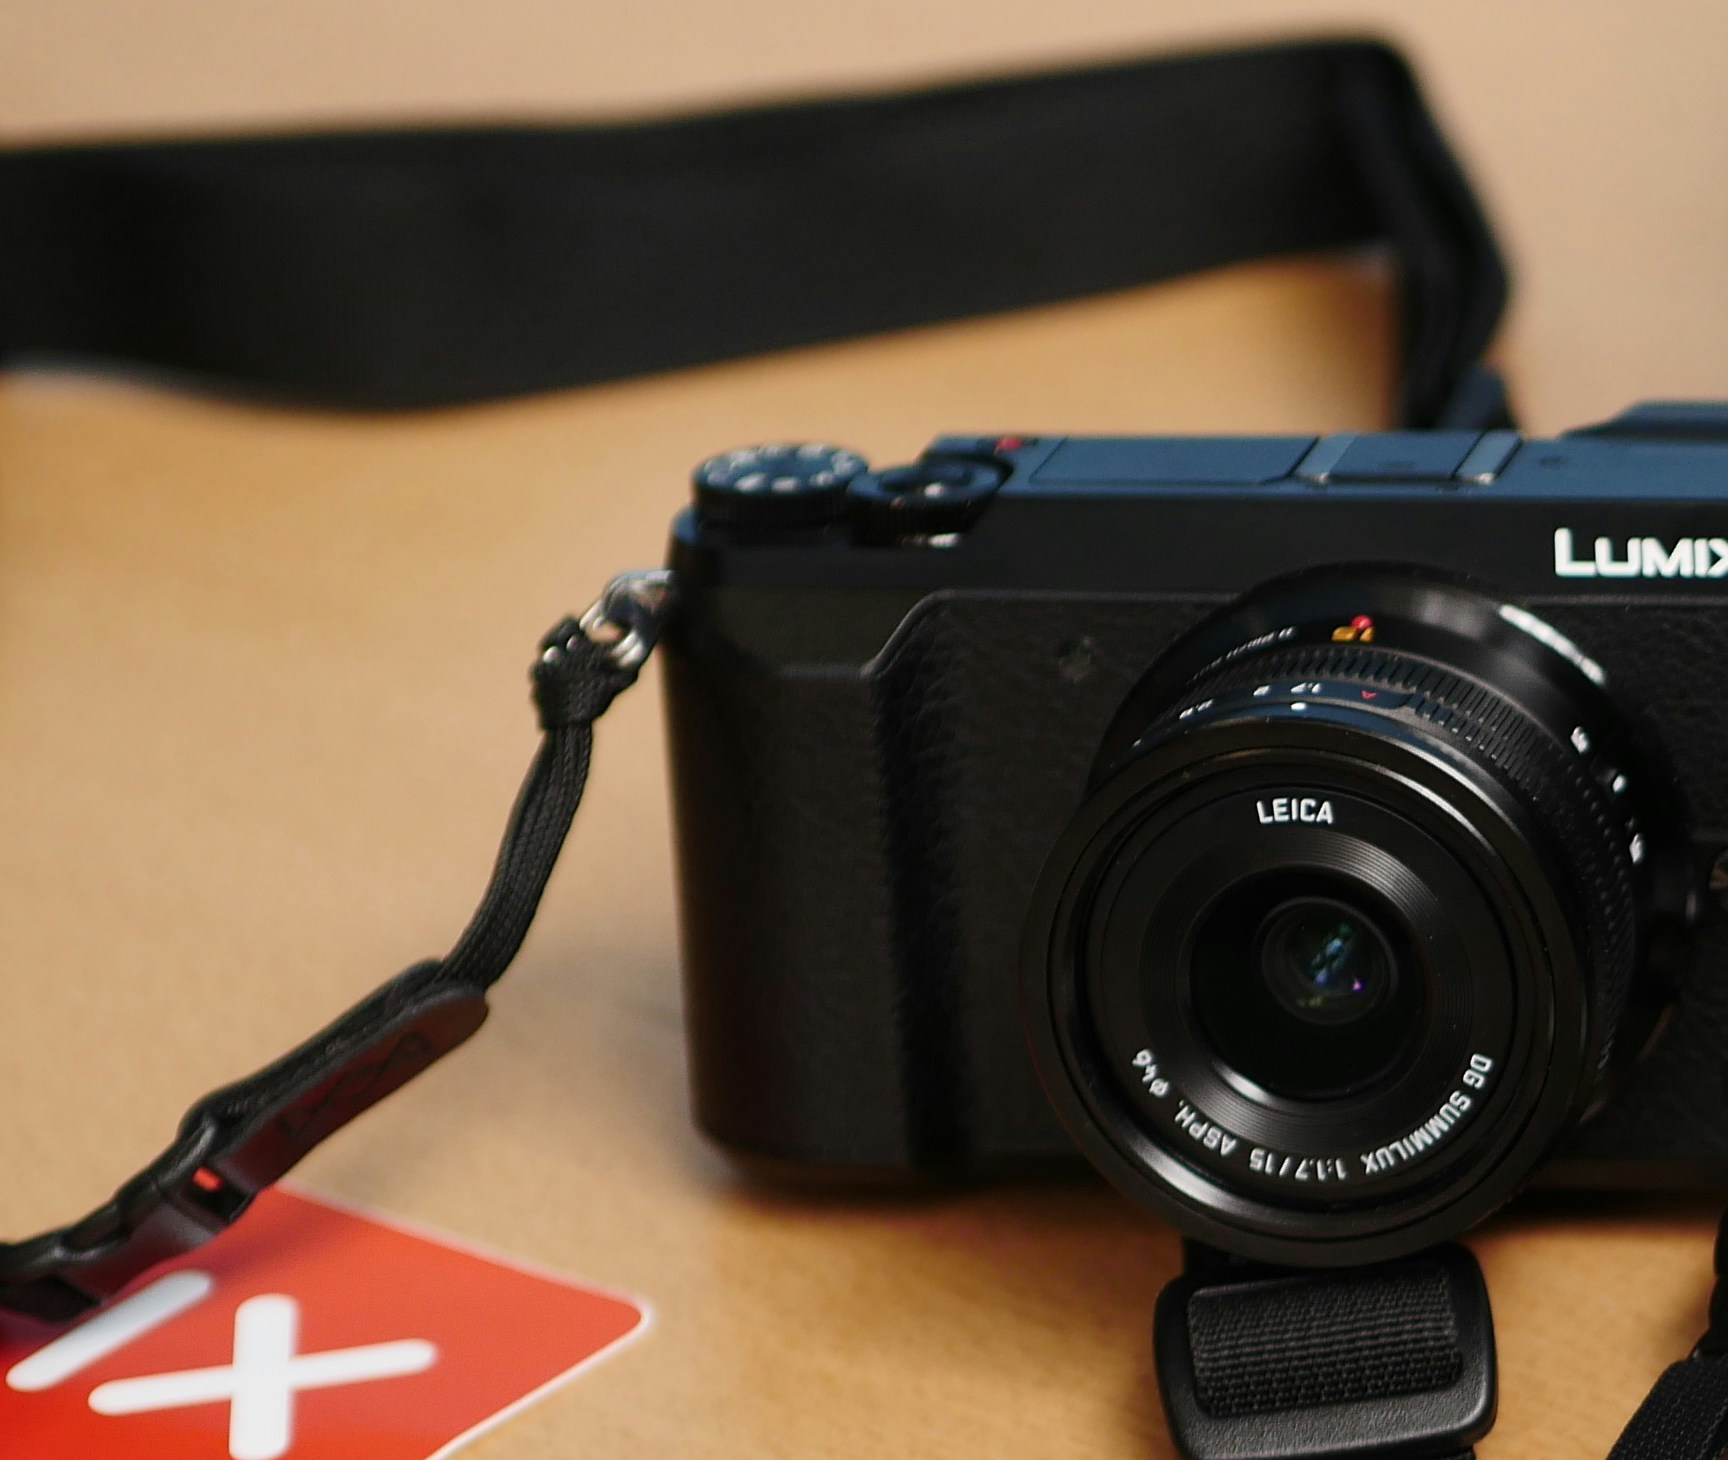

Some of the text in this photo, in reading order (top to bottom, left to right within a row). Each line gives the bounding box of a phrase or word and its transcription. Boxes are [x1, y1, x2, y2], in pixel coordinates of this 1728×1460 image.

[1256, 798, 1333, 824] LEICA
[1462, 1053, 1494, 1090] DG
[1360, 1090, 1473, 1175] SUMMILUX
